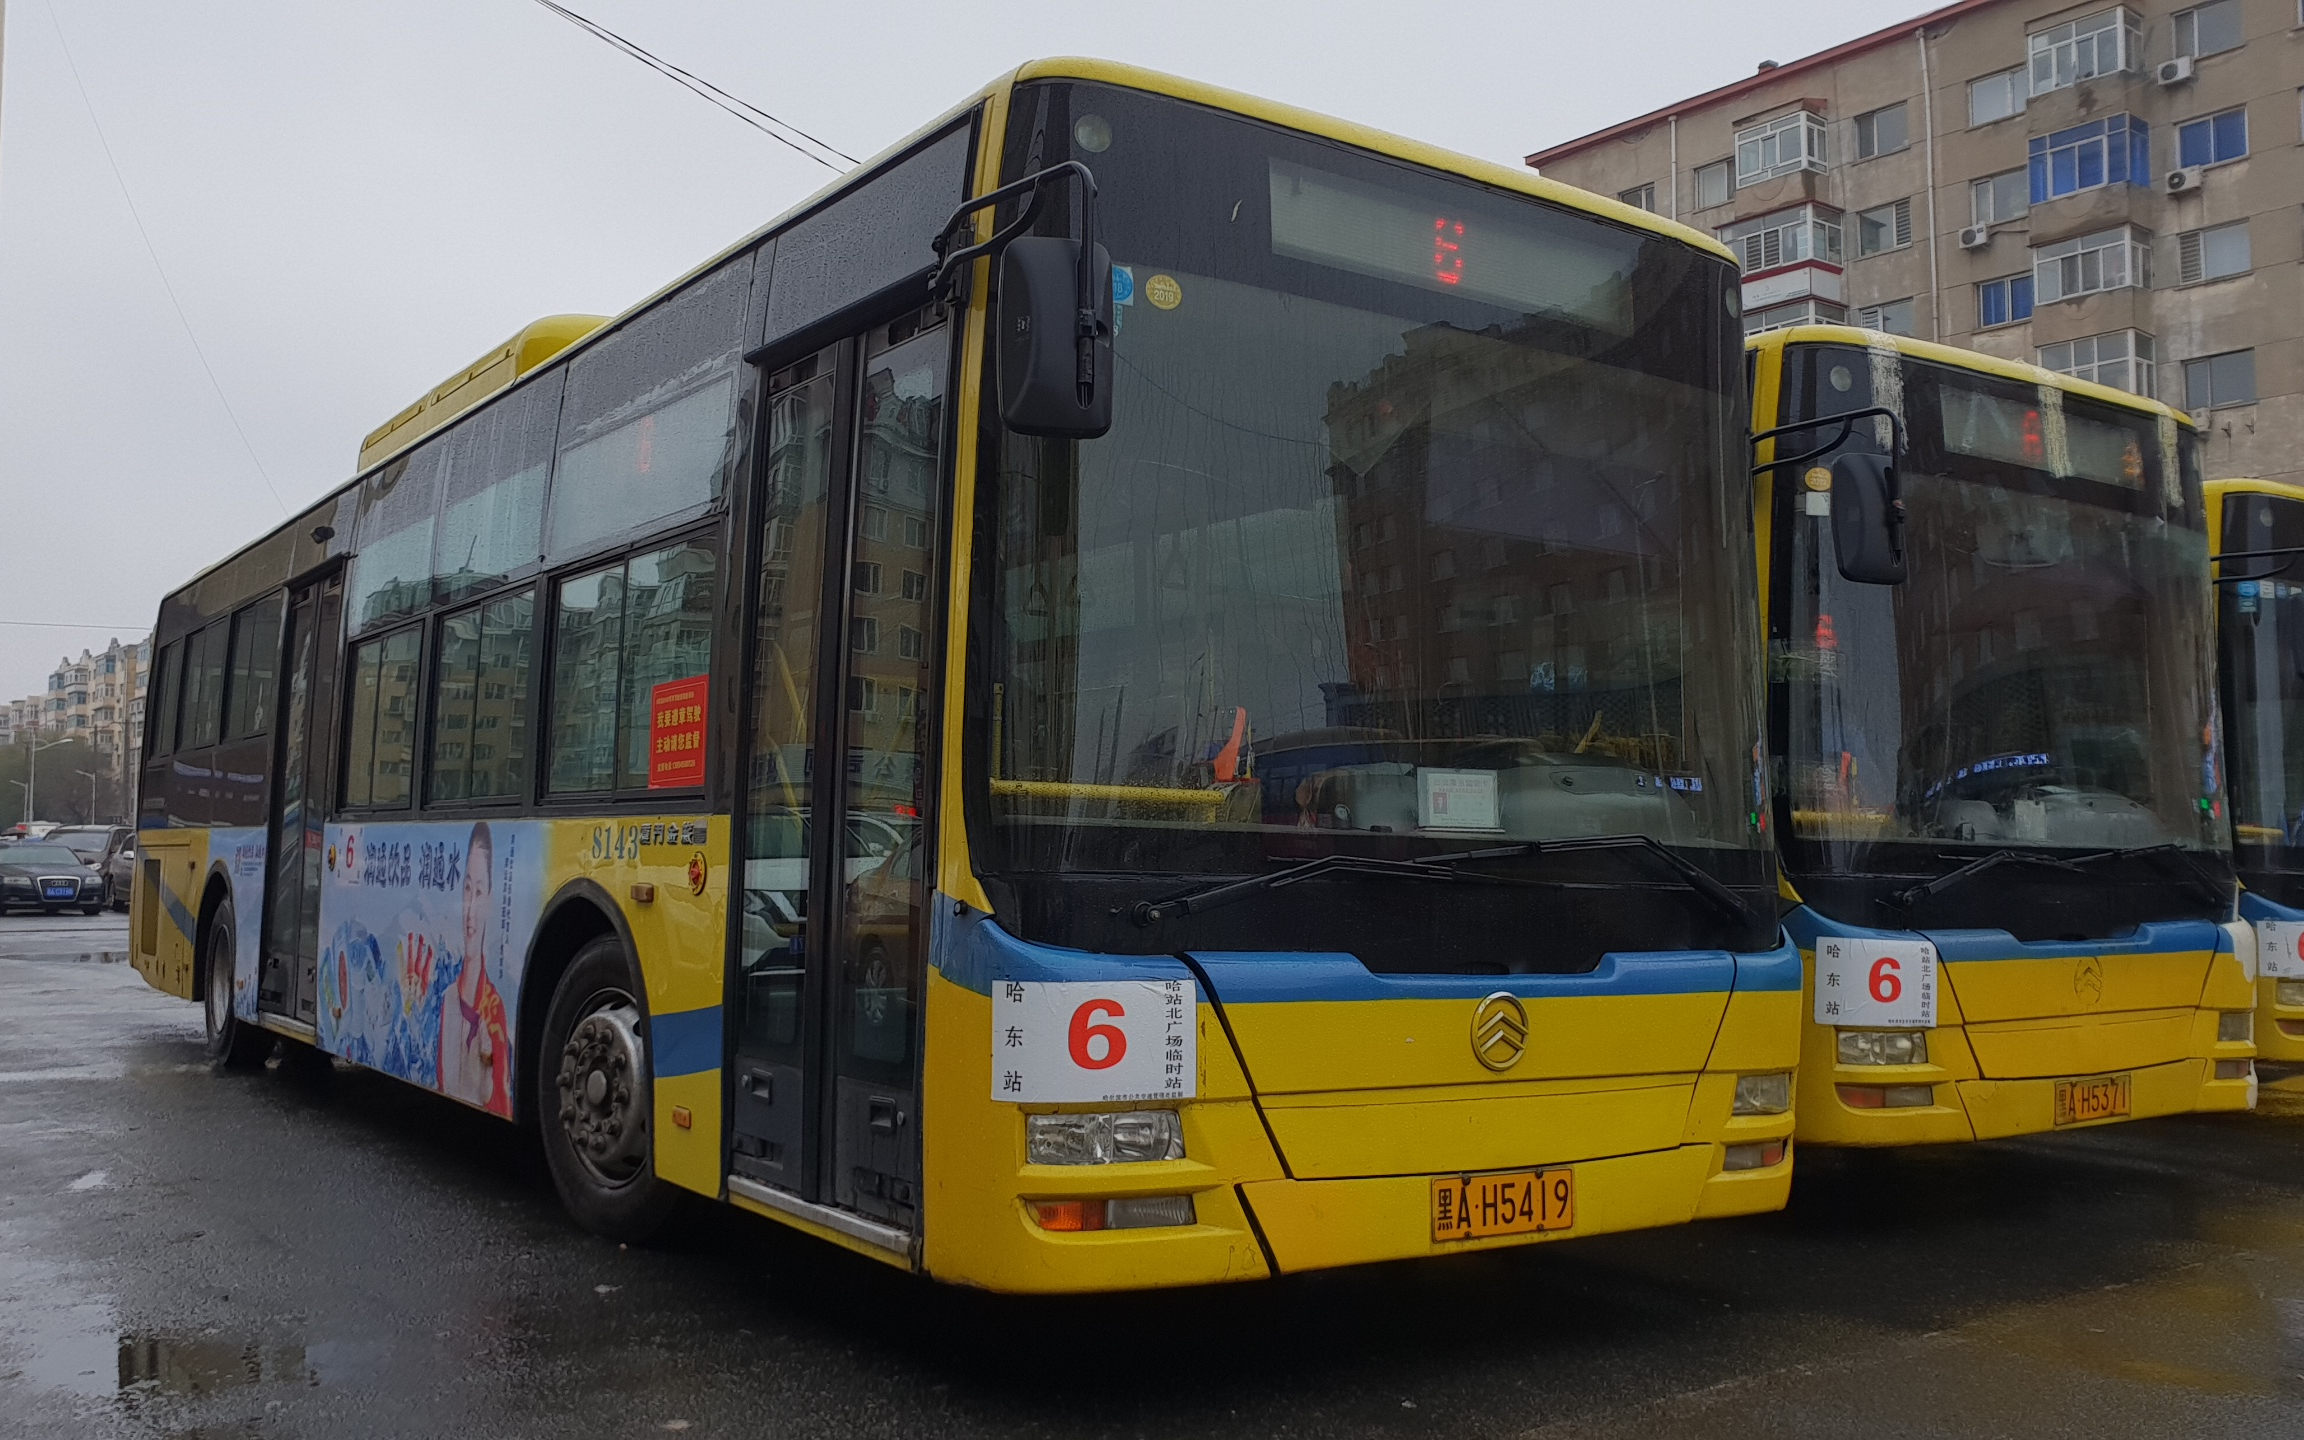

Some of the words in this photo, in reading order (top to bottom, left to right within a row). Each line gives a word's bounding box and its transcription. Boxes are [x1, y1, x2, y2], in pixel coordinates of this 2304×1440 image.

[1153, 289, 1174, 303] 2019
[345, 834, 355, 869] 6
[591, 825, 639, 860] 8143
[2265, 921, 2279, 972] 哈东站
[1824, 943, 1841, 1016] 哈东站
[1868, 956, 1902, 1004] 6
[1920, 946, 1931, 1018] 哈站北广场临时站
[1003, 980, 1026, 1093] 哈东站
[1067, 998, 1128, 1071] 6
[1164, 979, 1184, 1089] 哈站北广场临时站
[1437, 1178, 1569, 1231] 黑A·H5419
